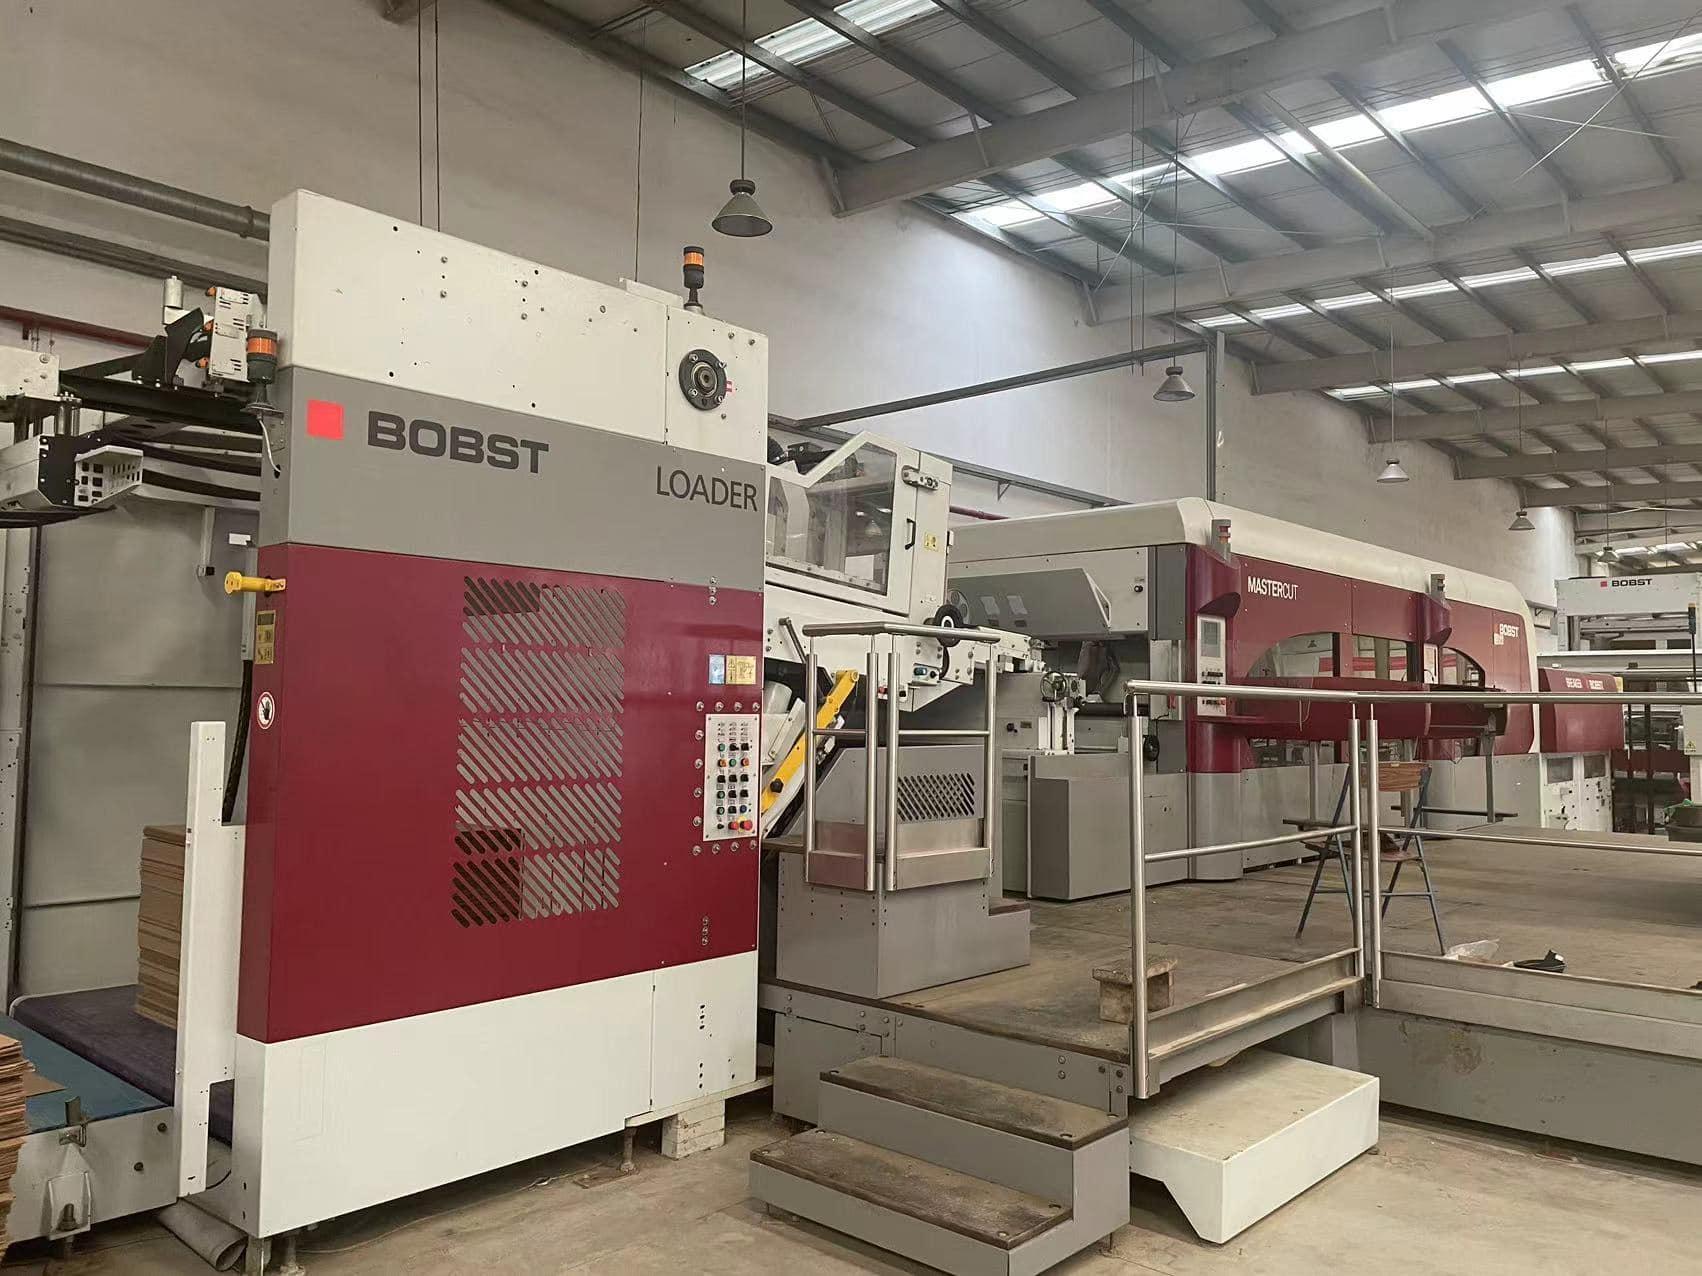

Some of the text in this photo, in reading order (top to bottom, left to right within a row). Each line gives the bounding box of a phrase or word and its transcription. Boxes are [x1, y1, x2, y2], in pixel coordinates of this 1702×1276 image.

[367, 411, 549, 473] BOBST
[656, 465, 758, 512] LOADER
[1247, 575, 1299, 601] MASTERCUT
[1611, 578, 1653, 587] BOBST
[1499, 623, 1520, 638] BOBST
